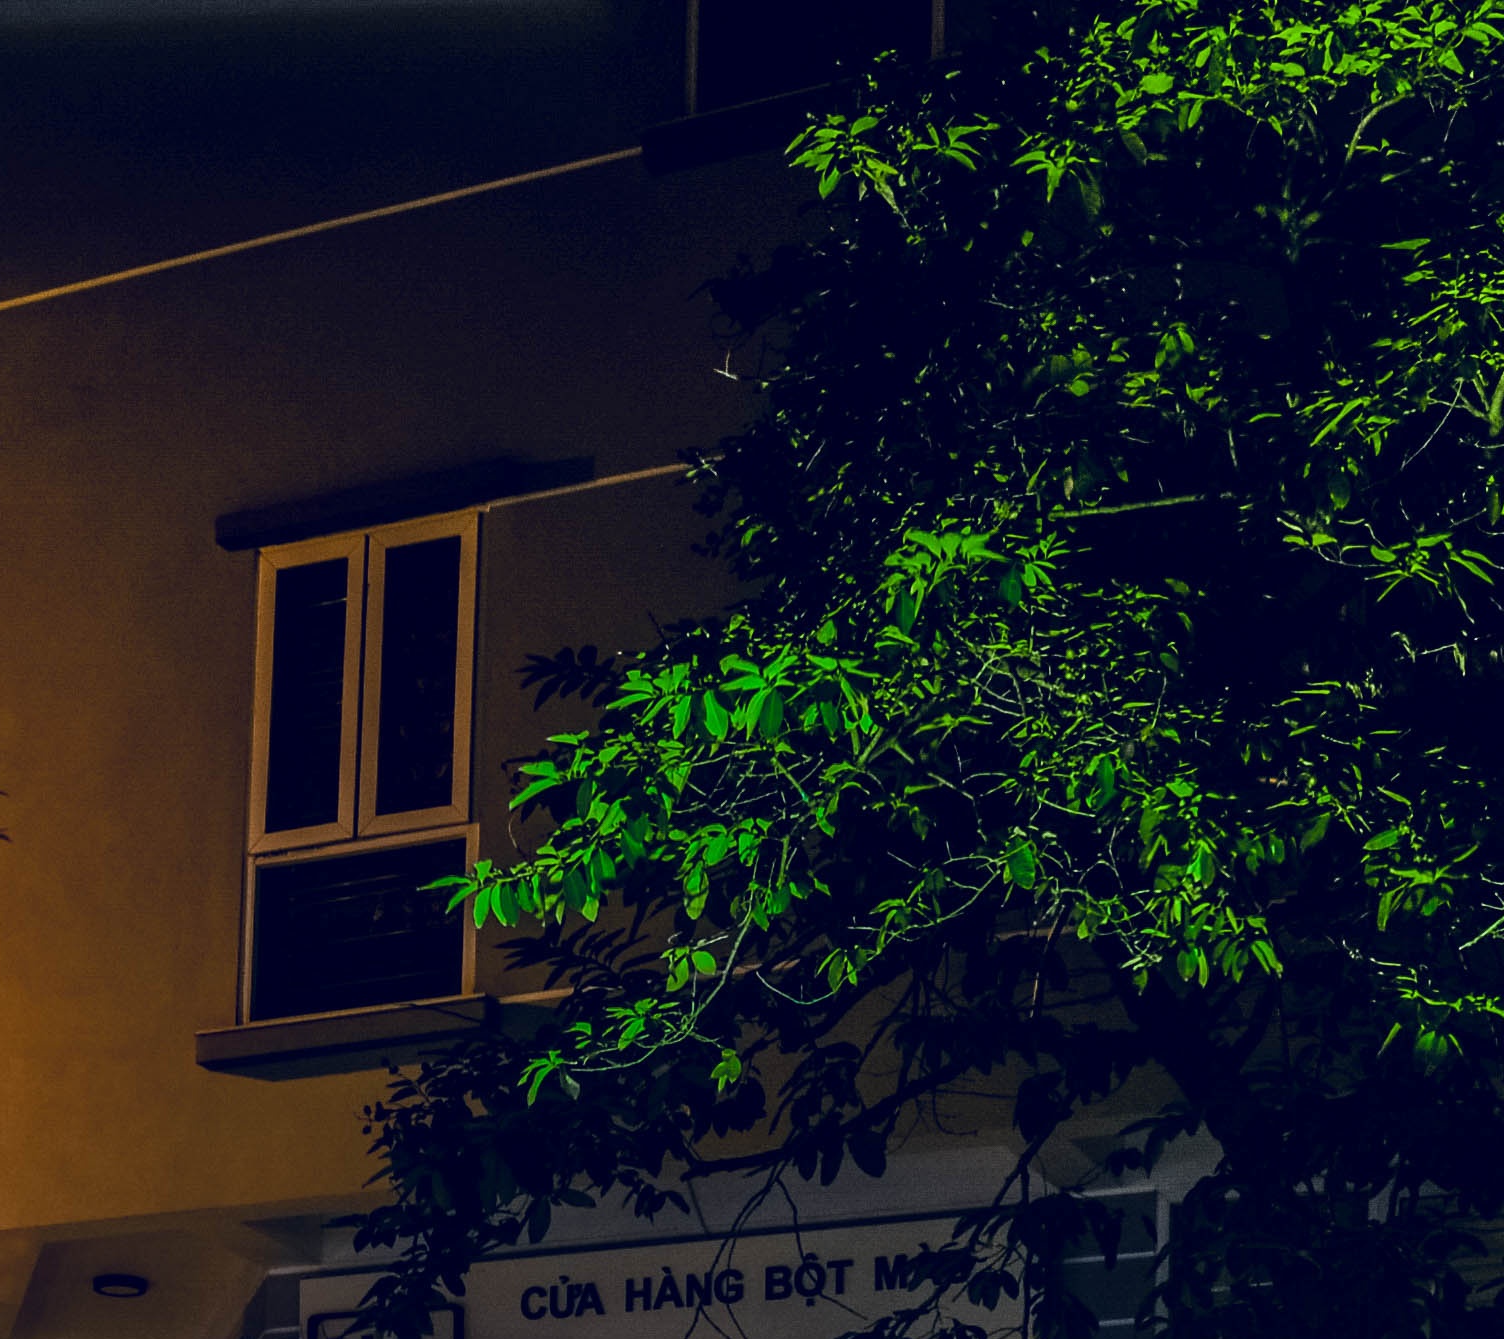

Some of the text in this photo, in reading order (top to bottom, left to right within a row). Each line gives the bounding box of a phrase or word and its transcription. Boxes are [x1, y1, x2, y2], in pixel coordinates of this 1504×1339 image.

[520, 1274, 605, 1320] CỬA
[625, 1267, 744, 1312] HÀNG
[765, 1253, 854, 1308] BỘT
